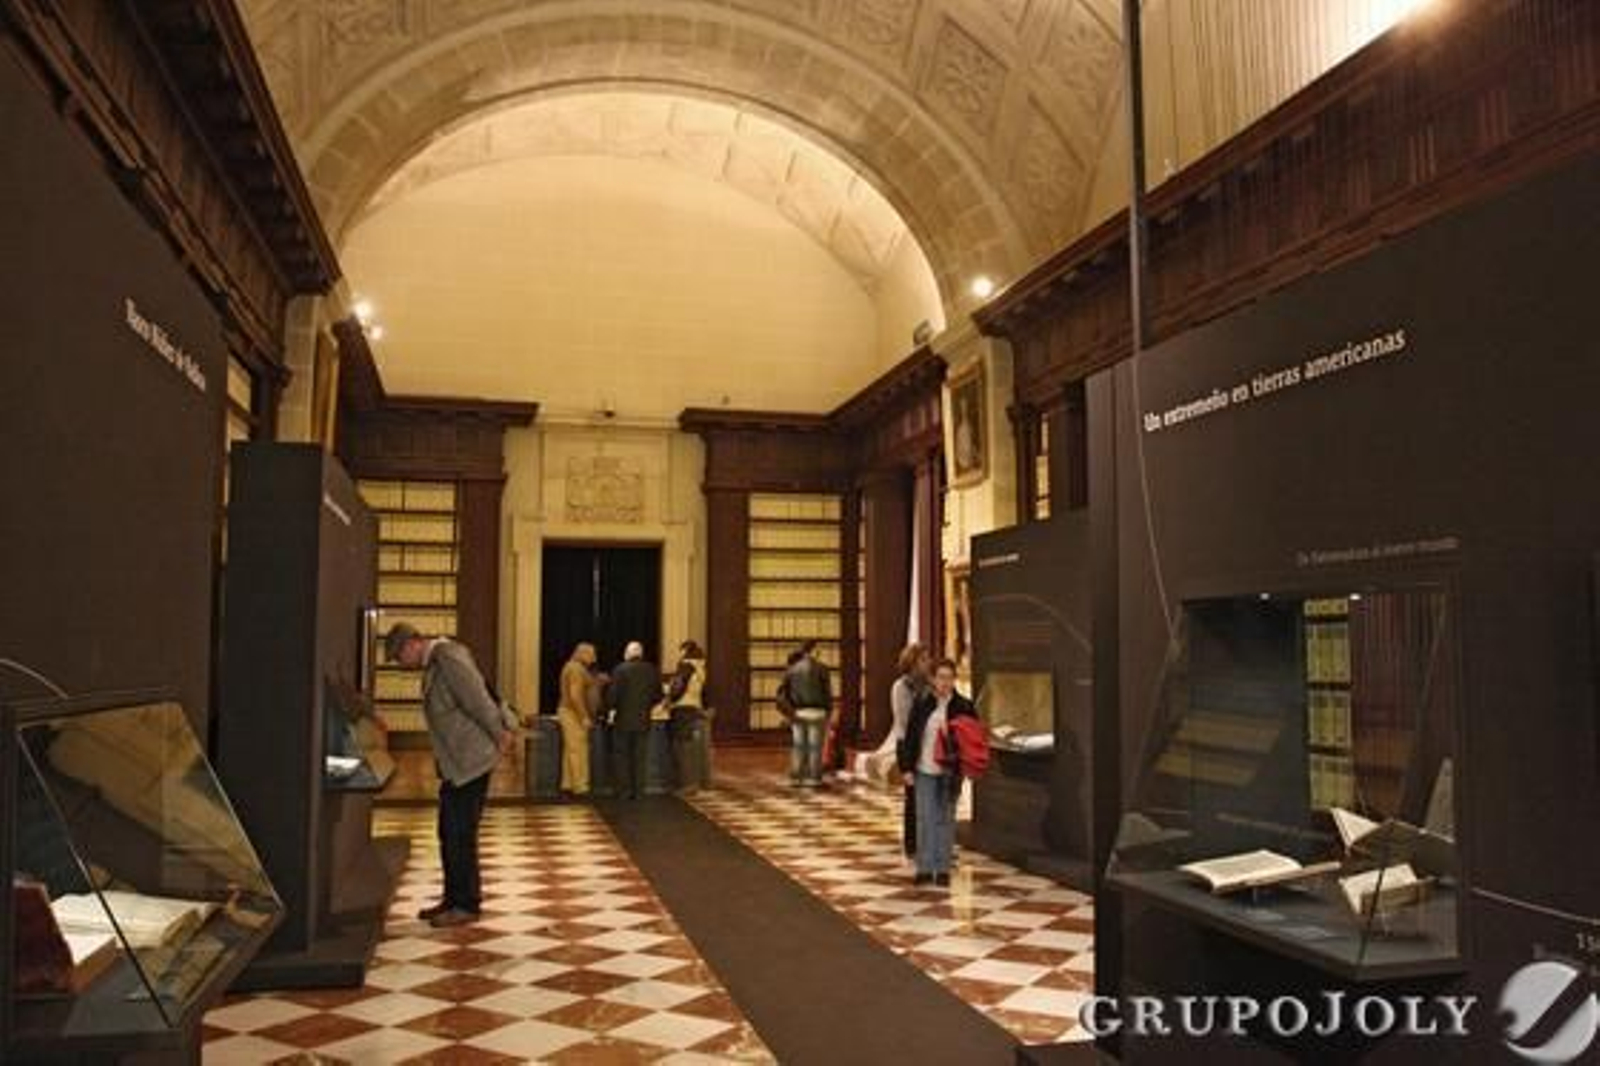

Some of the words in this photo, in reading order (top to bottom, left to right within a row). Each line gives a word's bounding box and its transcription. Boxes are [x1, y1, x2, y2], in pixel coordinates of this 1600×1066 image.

[1143, 411, 1161, 431] Un
[1164, 388, 1228, 426] extremeño
[1232, 383, 1249, 403] en
[1252, 371, 1300, 397] tierras
[1304, 329, 1406, 380] americanas
